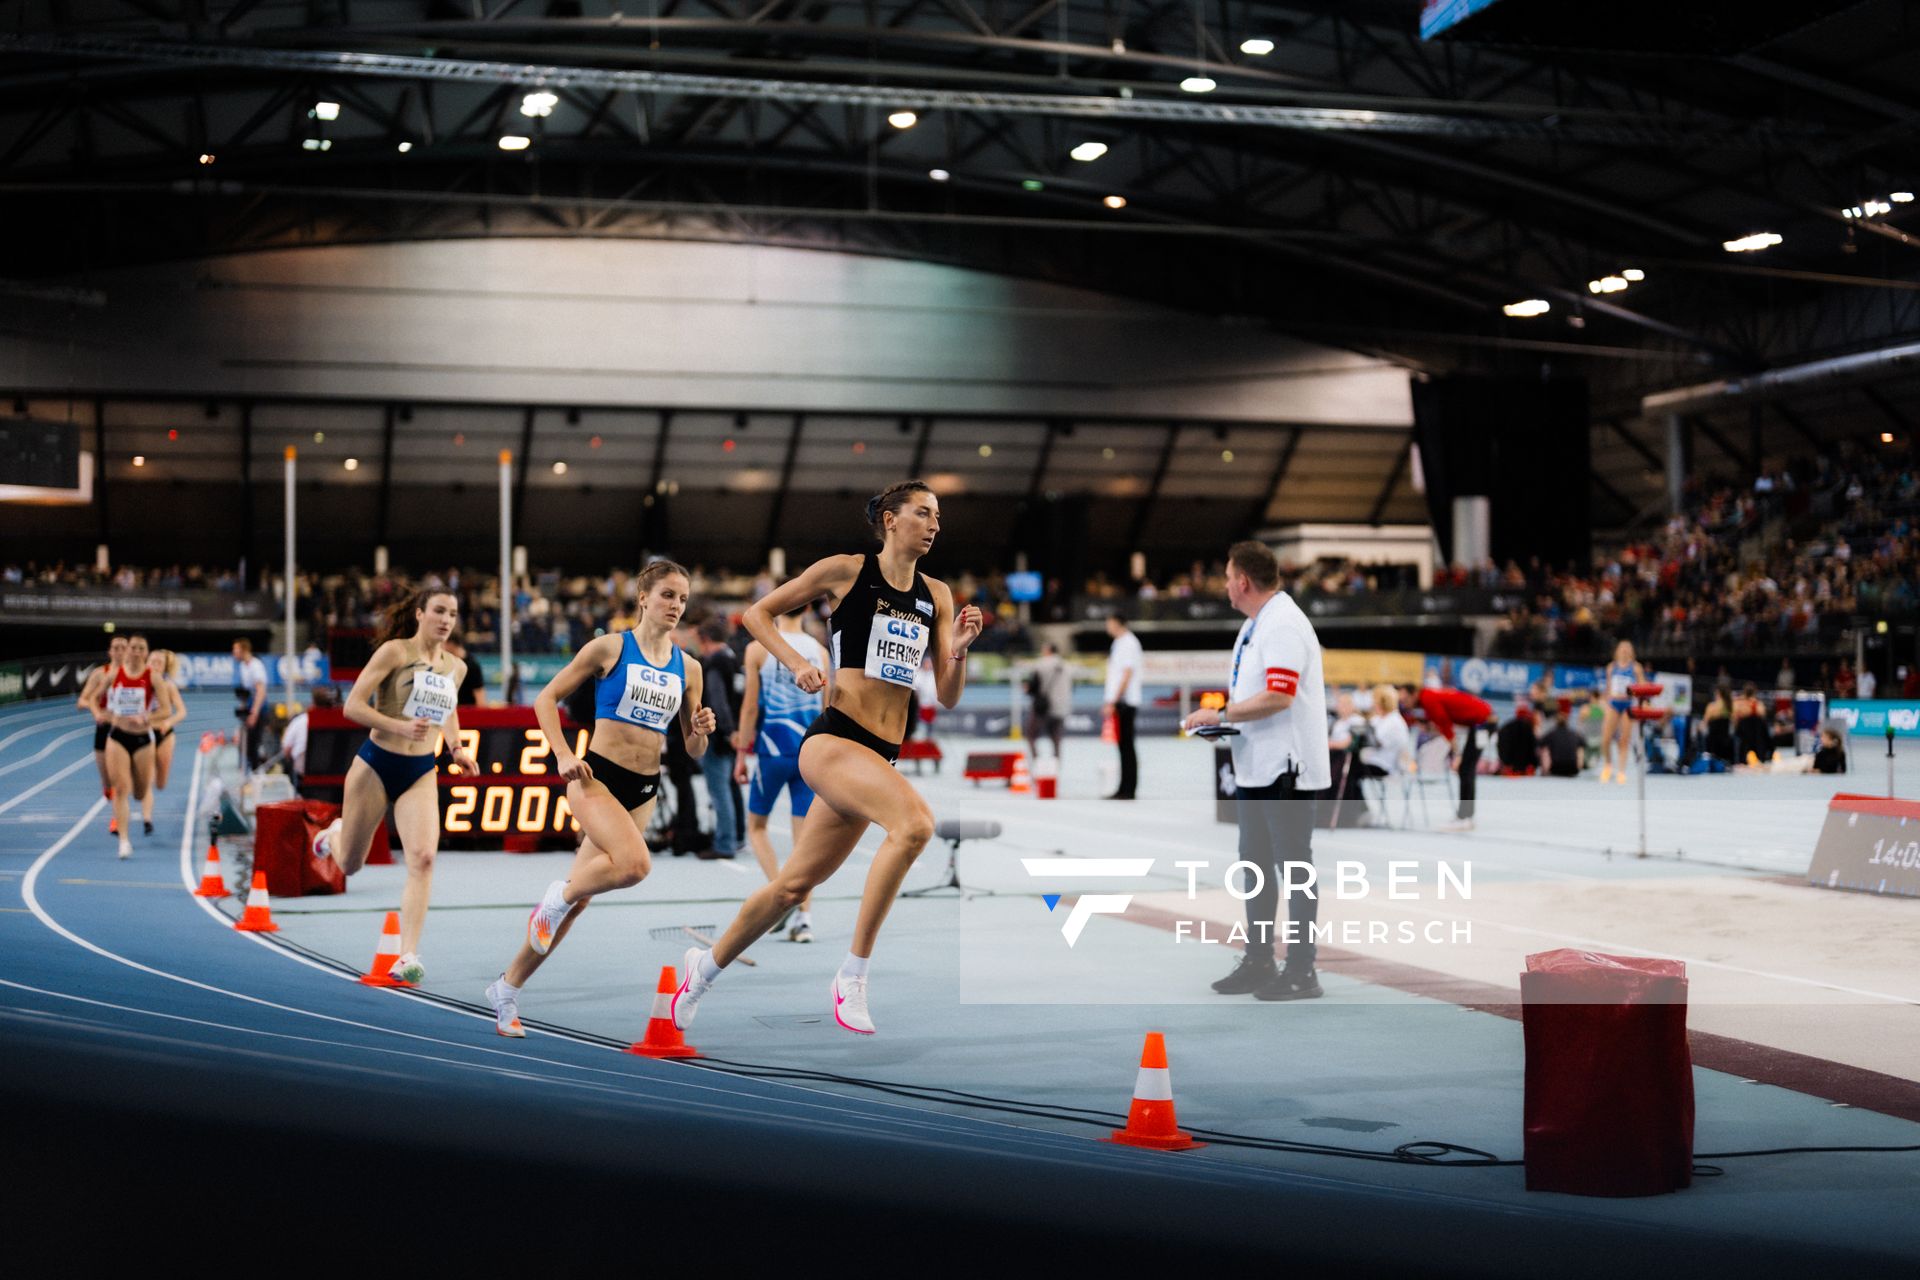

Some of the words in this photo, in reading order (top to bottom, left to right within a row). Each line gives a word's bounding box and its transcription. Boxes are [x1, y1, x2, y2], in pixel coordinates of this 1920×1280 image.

[887, 620, 920, 641] GLS
[877, 639, 920, 667] HERING
[425, 675, 446, 689] GLS
[640, 669, 668, 687] GLS
[630, 684, 677, 712] WILHELM
